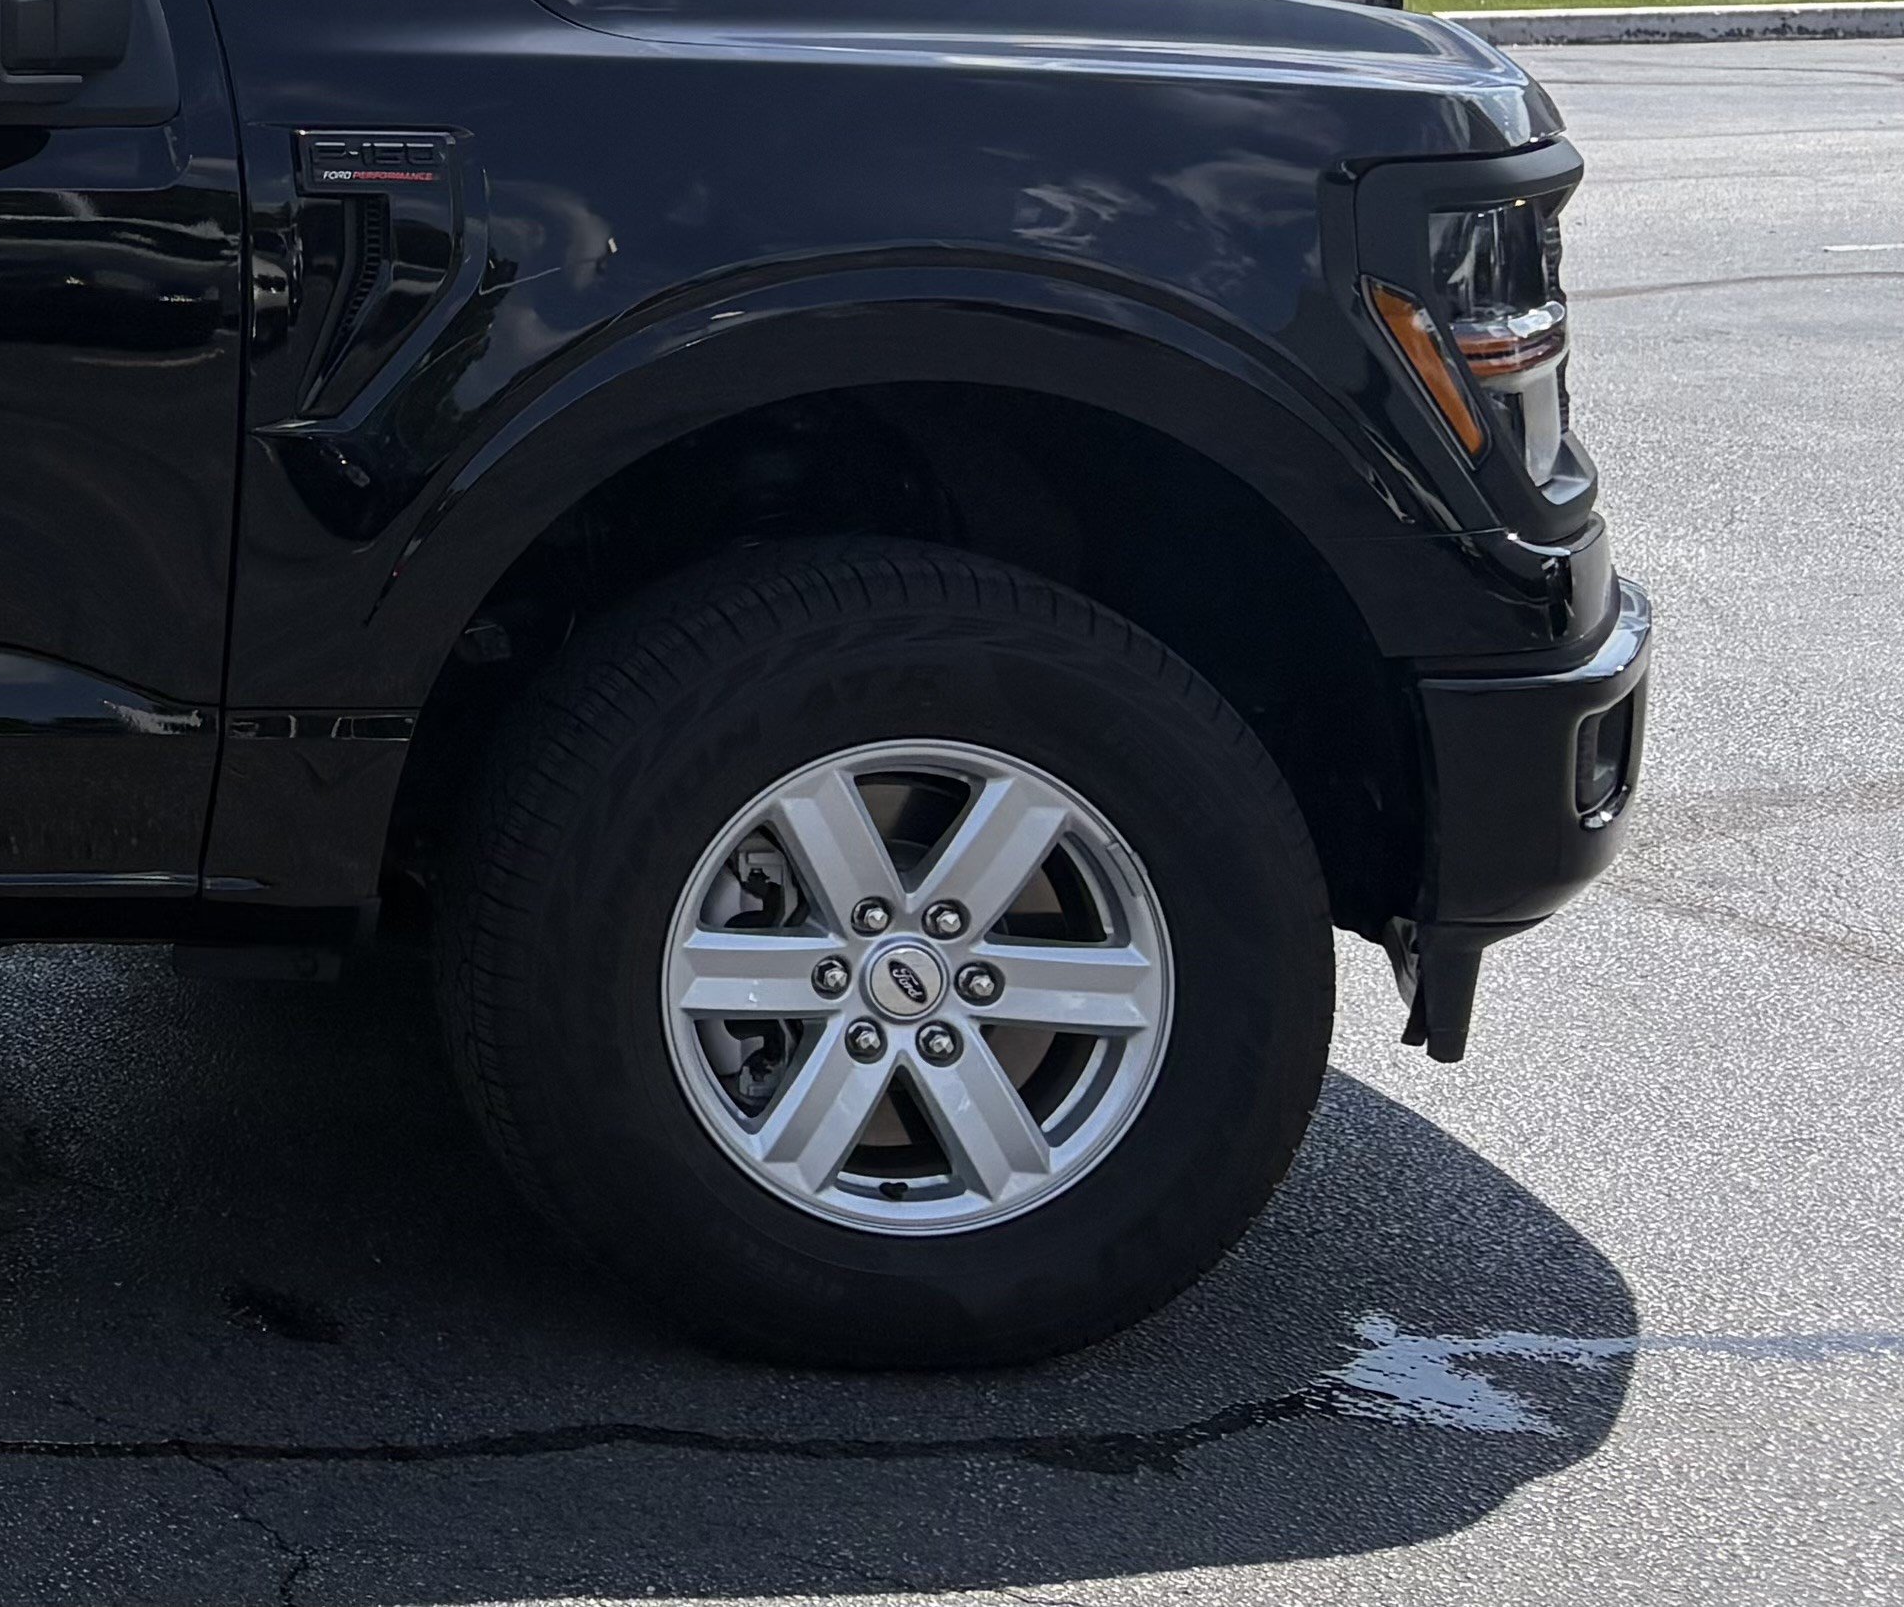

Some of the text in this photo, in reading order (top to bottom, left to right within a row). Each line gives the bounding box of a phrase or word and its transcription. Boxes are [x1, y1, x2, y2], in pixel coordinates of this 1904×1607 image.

[323, 170, 433, 181] FORD PERFORMANCE
[893, 968, 922, 998] Ford
